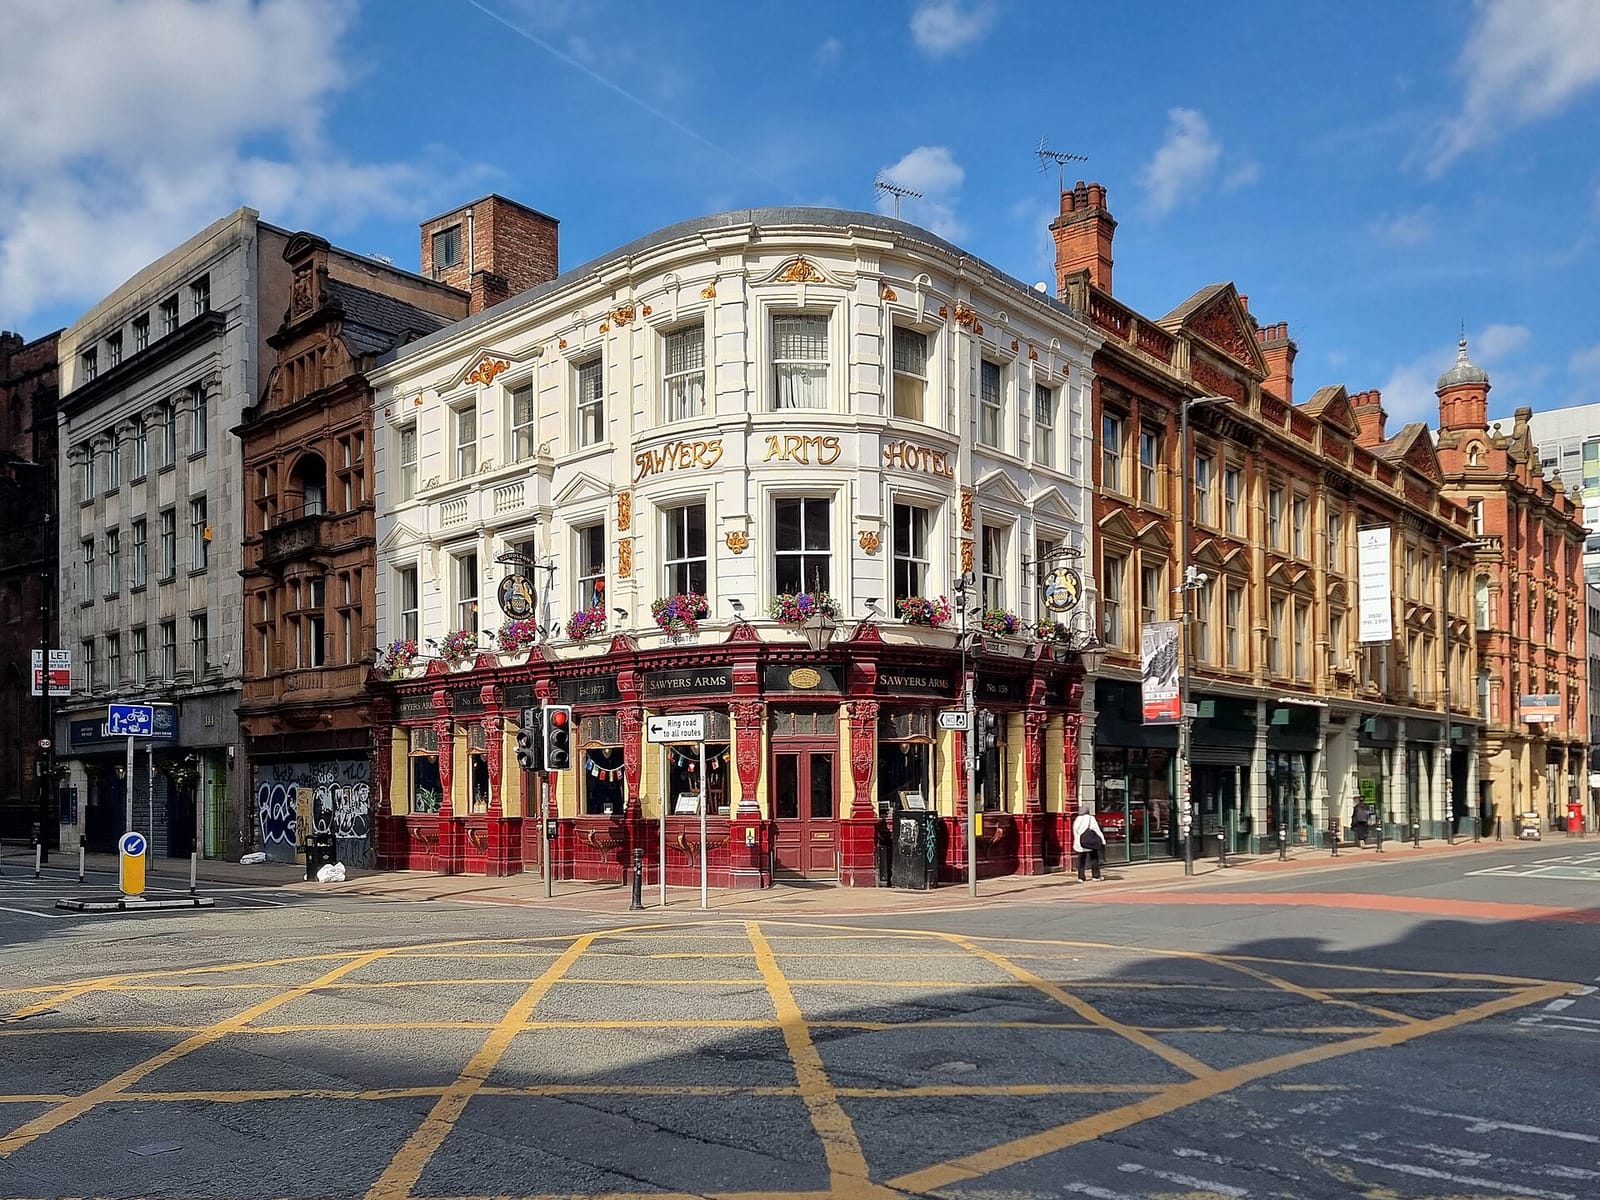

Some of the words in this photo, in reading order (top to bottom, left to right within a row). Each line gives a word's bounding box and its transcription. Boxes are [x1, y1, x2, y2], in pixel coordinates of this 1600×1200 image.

[634, 439, 723, 483] SAWYERS
[763, 435, 841, 465] ARMS
[884, 441, 954, 479] HOTEL
[50, 651, 69, 660] LET
[650, 679, 692, 690] SAWYERS
[694, 676, 727, 687] ARMS
[880, 674, 926, 687] SAWYERS
[928, 677, 949, 688] ARMS
[667, 719, 681, 729] Ring
[682, 718, 697, 727] road
[663, 730, 670, 738] to
[671, 729, 680, 737] all
[681, 729, 702, 737] routes
